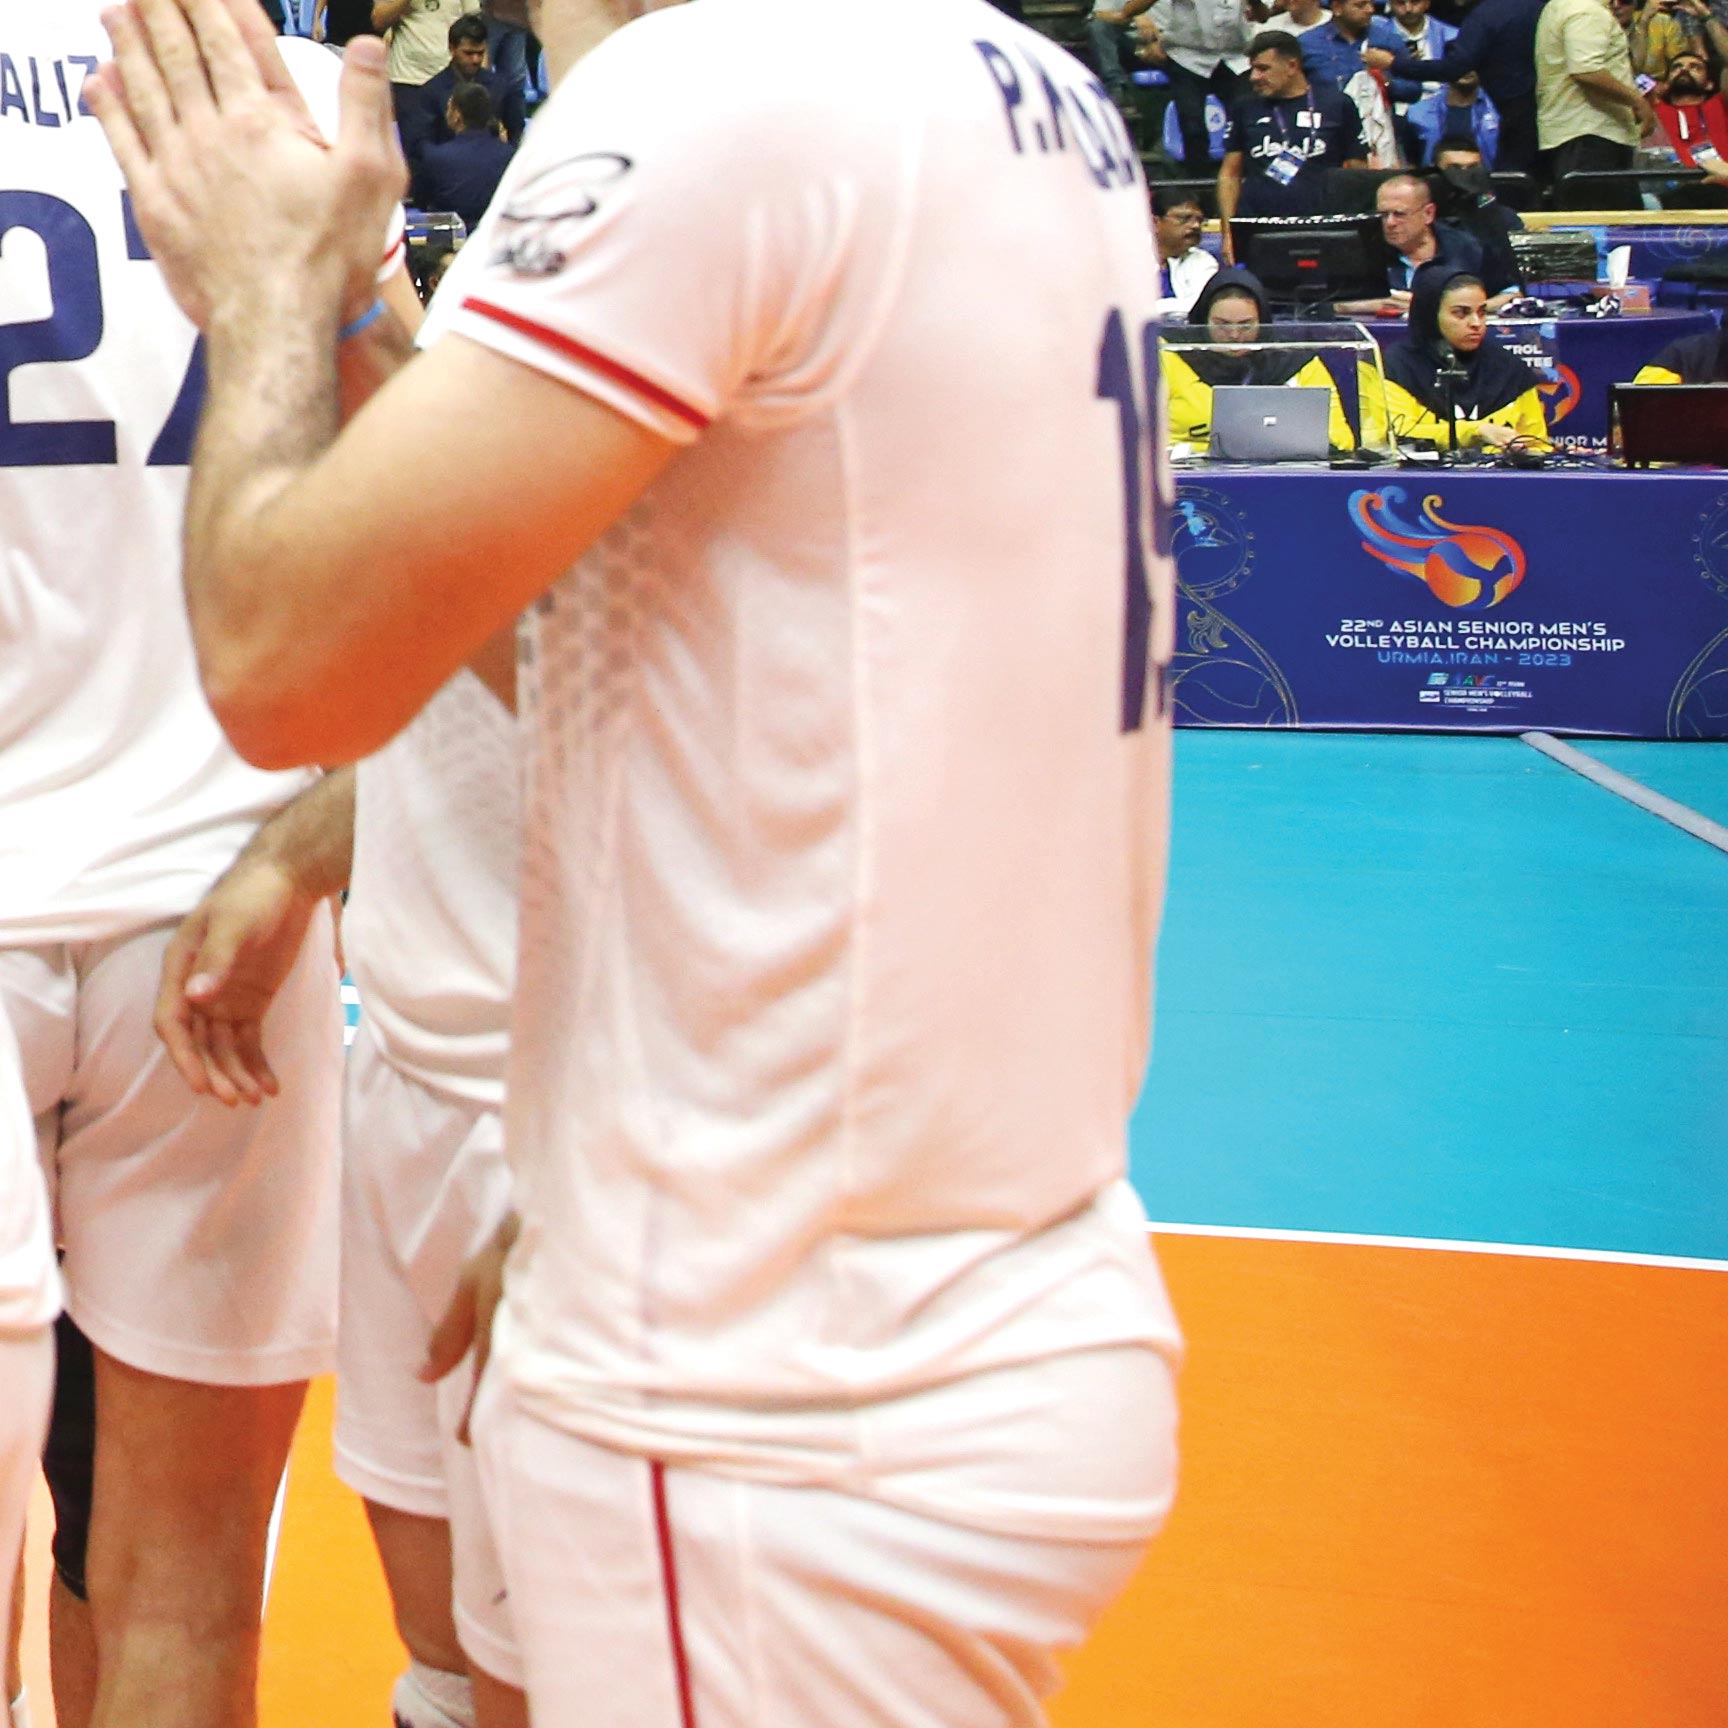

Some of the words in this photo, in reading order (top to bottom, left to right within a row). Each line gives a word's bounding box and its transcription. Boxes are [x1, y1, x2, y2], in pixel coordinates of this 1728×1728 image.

[1340, 618, 1384, 633] 22ND
[1389, 620, 1453, 634] ASIAN
[1457, 620, 1534, 635] SENIOR
[1539, 621, 1607, 636] MEN'S
[1325, 634, 1460, 649] VOLLEYBALL
[1464, 636, 1626, 652] CHAMPIONSHIP
[1518, 652, 1572, 667] 2023
